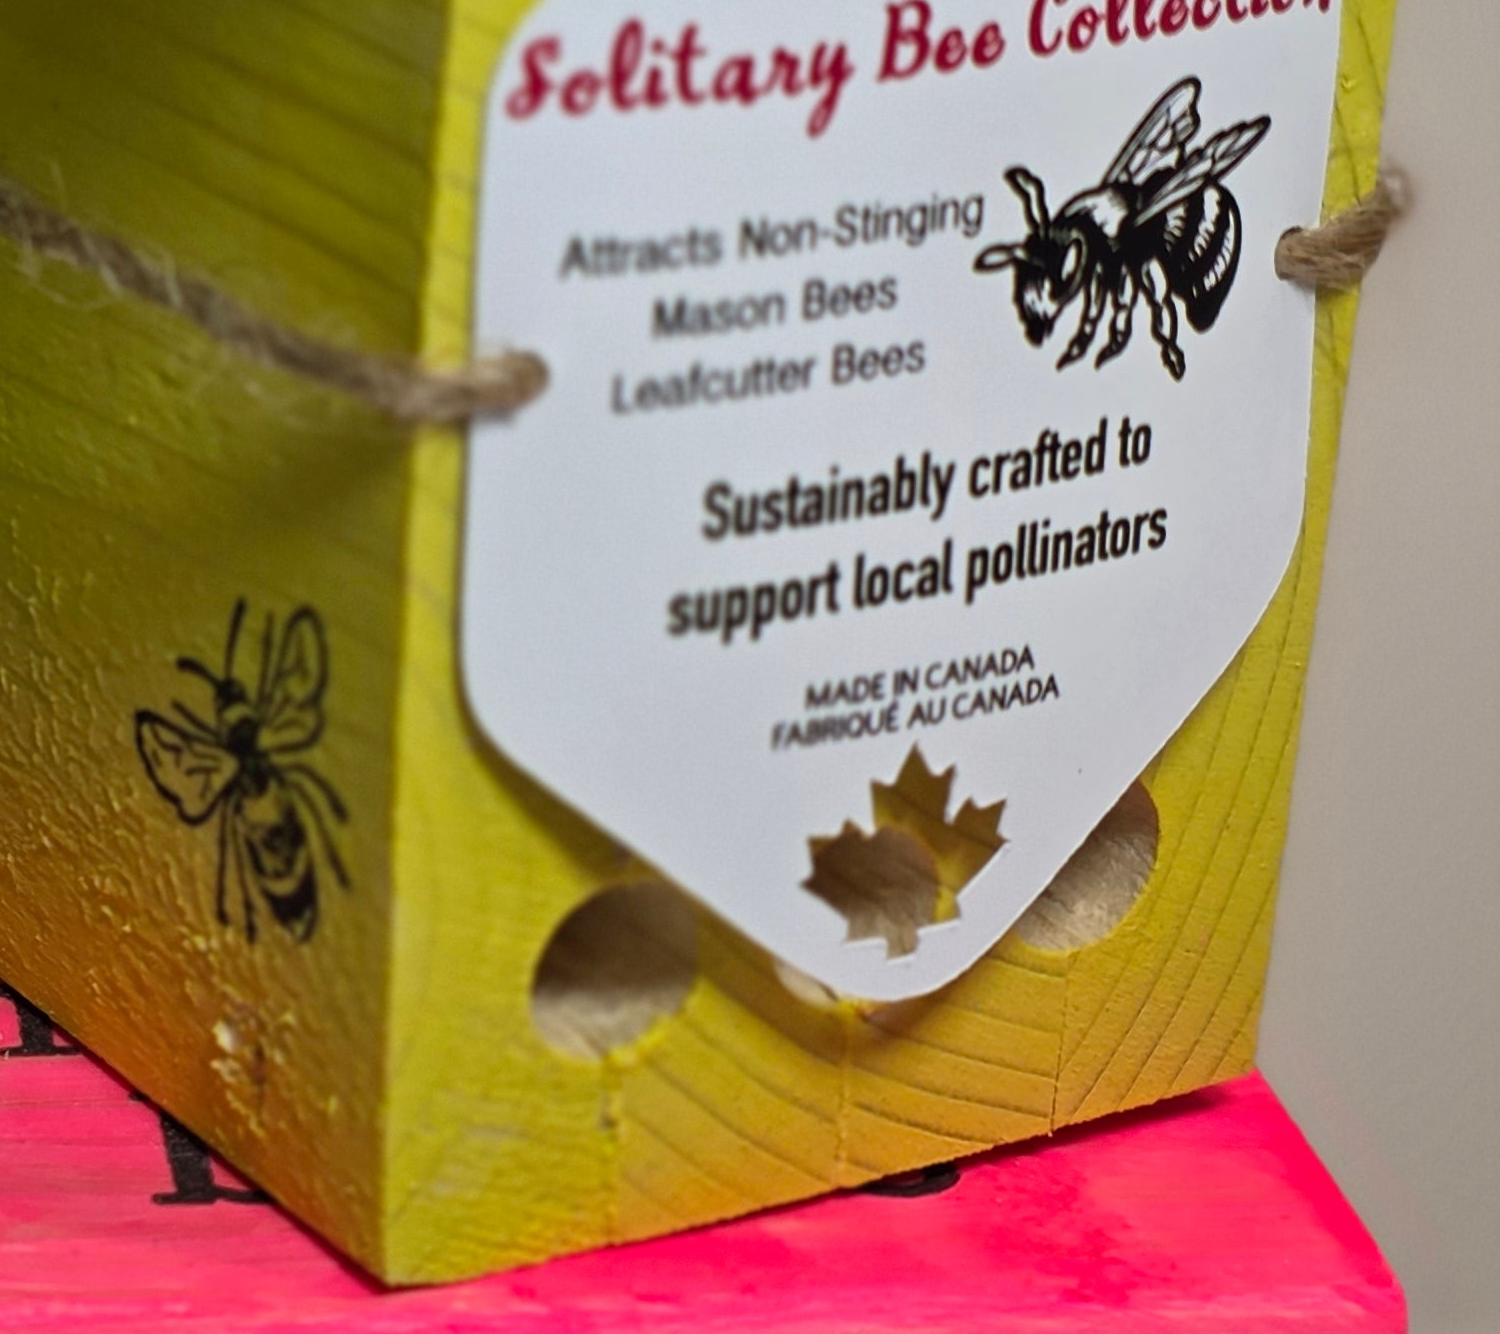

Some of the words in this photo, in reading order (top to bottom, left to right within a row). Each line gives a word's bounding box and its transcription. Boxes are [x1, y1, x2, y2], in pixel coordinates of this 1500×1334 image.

[504, 18, 854, 137] Solitary
[878, 0, 1005, 84] Bee
[559, 230, 721, 279] Attracts
[739, 193, 984, 256] Non-Stinging
[652, 293, 784, 341] Mason
[802, 279, 898, 323] Bees
[611, 355, 818, 415] Leafcutter
[831, 340, 925, 386] Bees
[701, 450, 955, 540] Sustainably
[967, 418, 1107, 501] crafted
[1118, 415, 1152, 464] to
[667, 562, 840, 646] support
[853, 542, 953, 612] local
[966, 503, 1168, 603] pollinators
[771, 700, 900, 751] FABRIQUÉ
[907, 694, 947, 729] AU
[952, 674, 1060, 720] CANADA
[805, 672, 885, 710] MADE
[893, 668, 919, 698] IN
[924, 646, 1035, 692] CANADA
